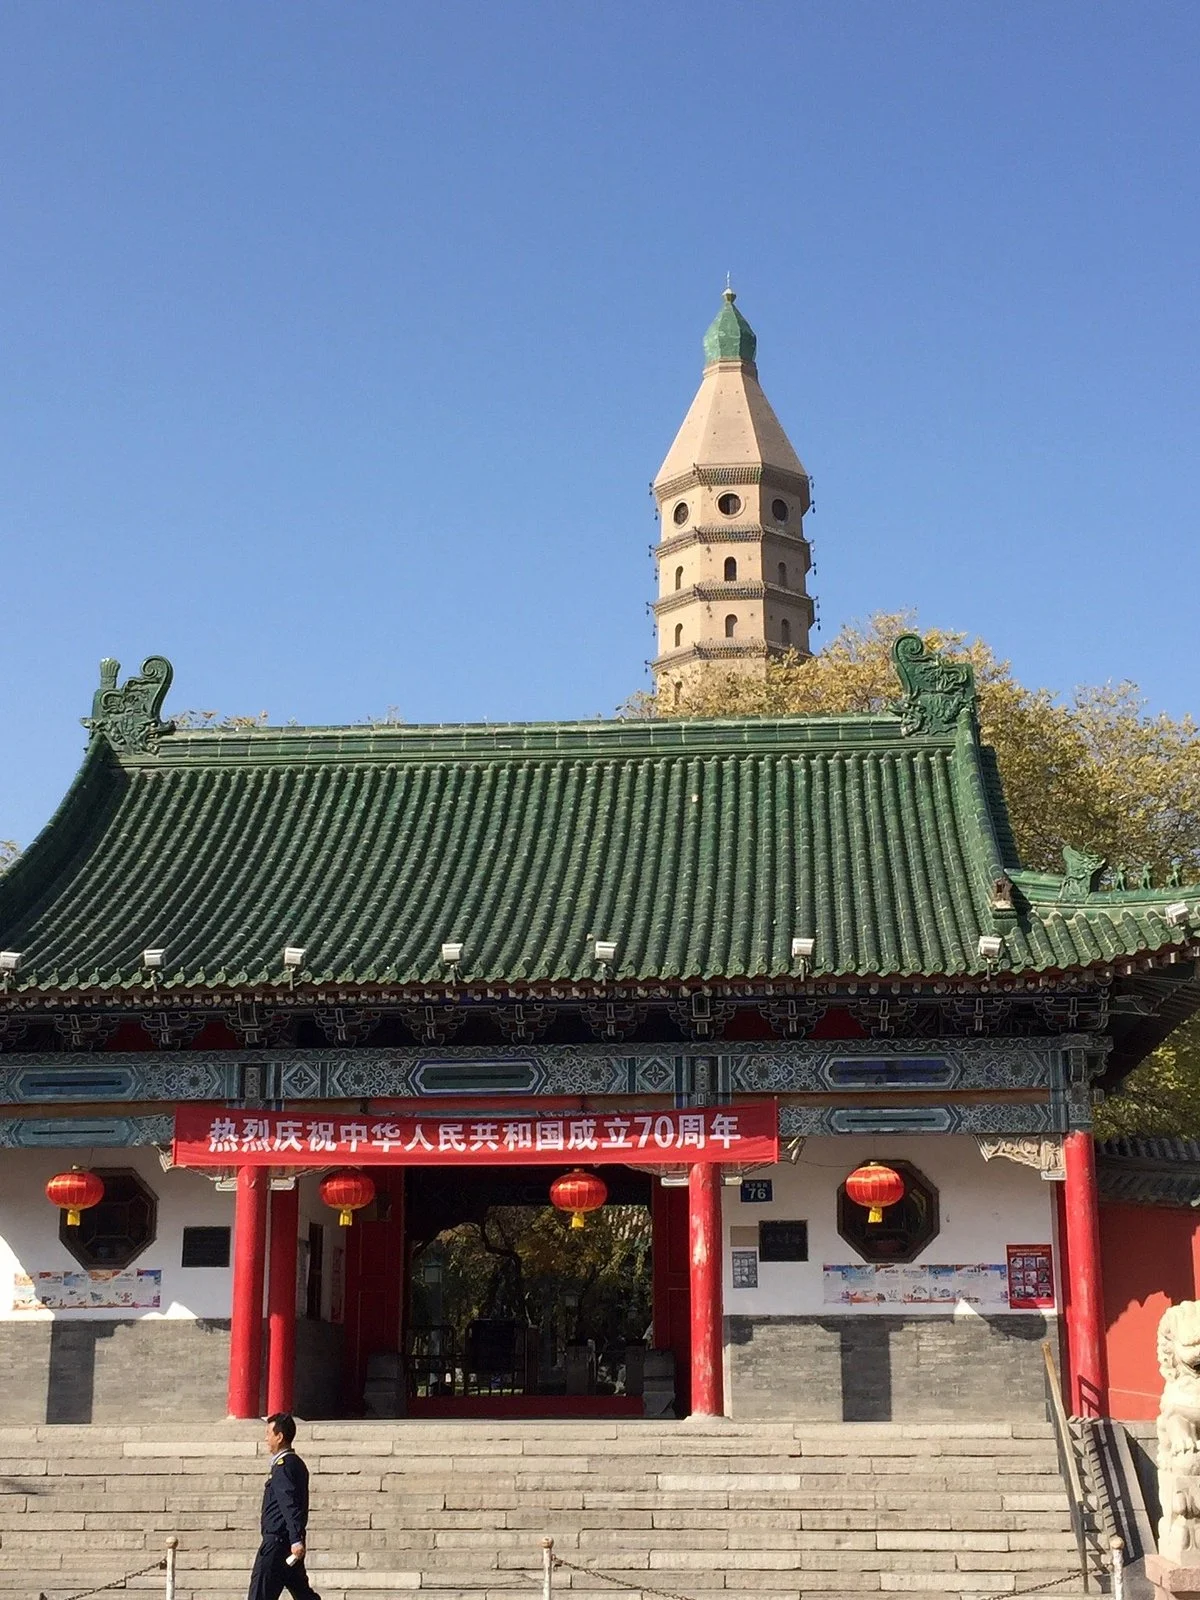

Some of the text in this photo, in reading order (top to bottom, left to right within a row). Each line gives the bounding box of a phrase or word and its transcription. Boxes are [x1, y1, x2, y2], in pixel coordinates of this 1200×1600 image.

[208, 1114, 741, 1153] 热烈庆祝中华人民共和国成立70周年
[748, 1188, 767, 1200] 76
